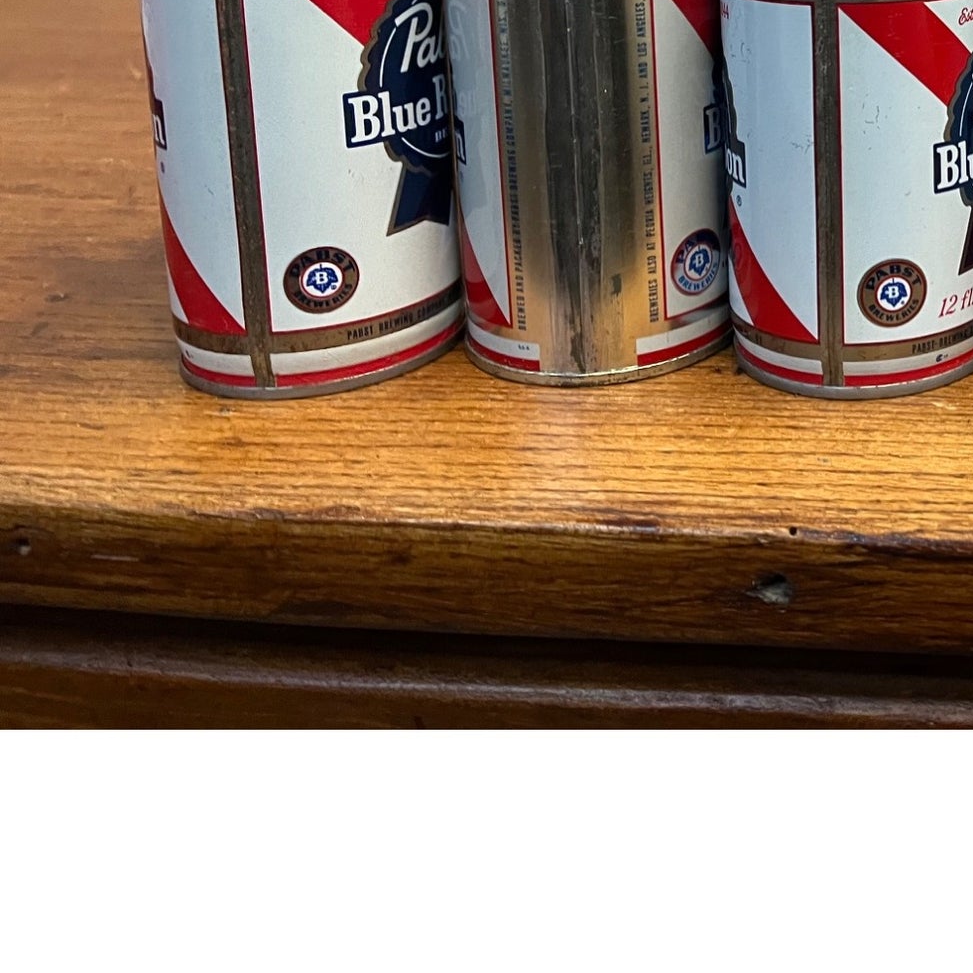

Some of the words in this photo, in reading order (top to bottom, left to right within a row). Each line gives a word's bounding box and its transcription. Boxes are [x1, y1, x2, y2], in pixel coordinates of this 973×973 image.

[635, 0, 646, 38] ANGELES,
[637, 42, 647, 57] LOS
[638, 62, 648, 79] AND
[347, 90, 432, 144] Blue
[644, 210, 655, 237] PEORIA
[645, 241, 655, 251] AT
[646, 255, 656, 274] ALSO
[516, 276, 525, 293] AND
[866, 264, 922, 291] PABST
[647, 279, 659, 323] BREWERIES
[868, 297, 919, 322] BREWERIES
[938, 294, 958, 318] 12
[347, 325, 373, 341] PABST
[911, 340, 935, 355] PABST
